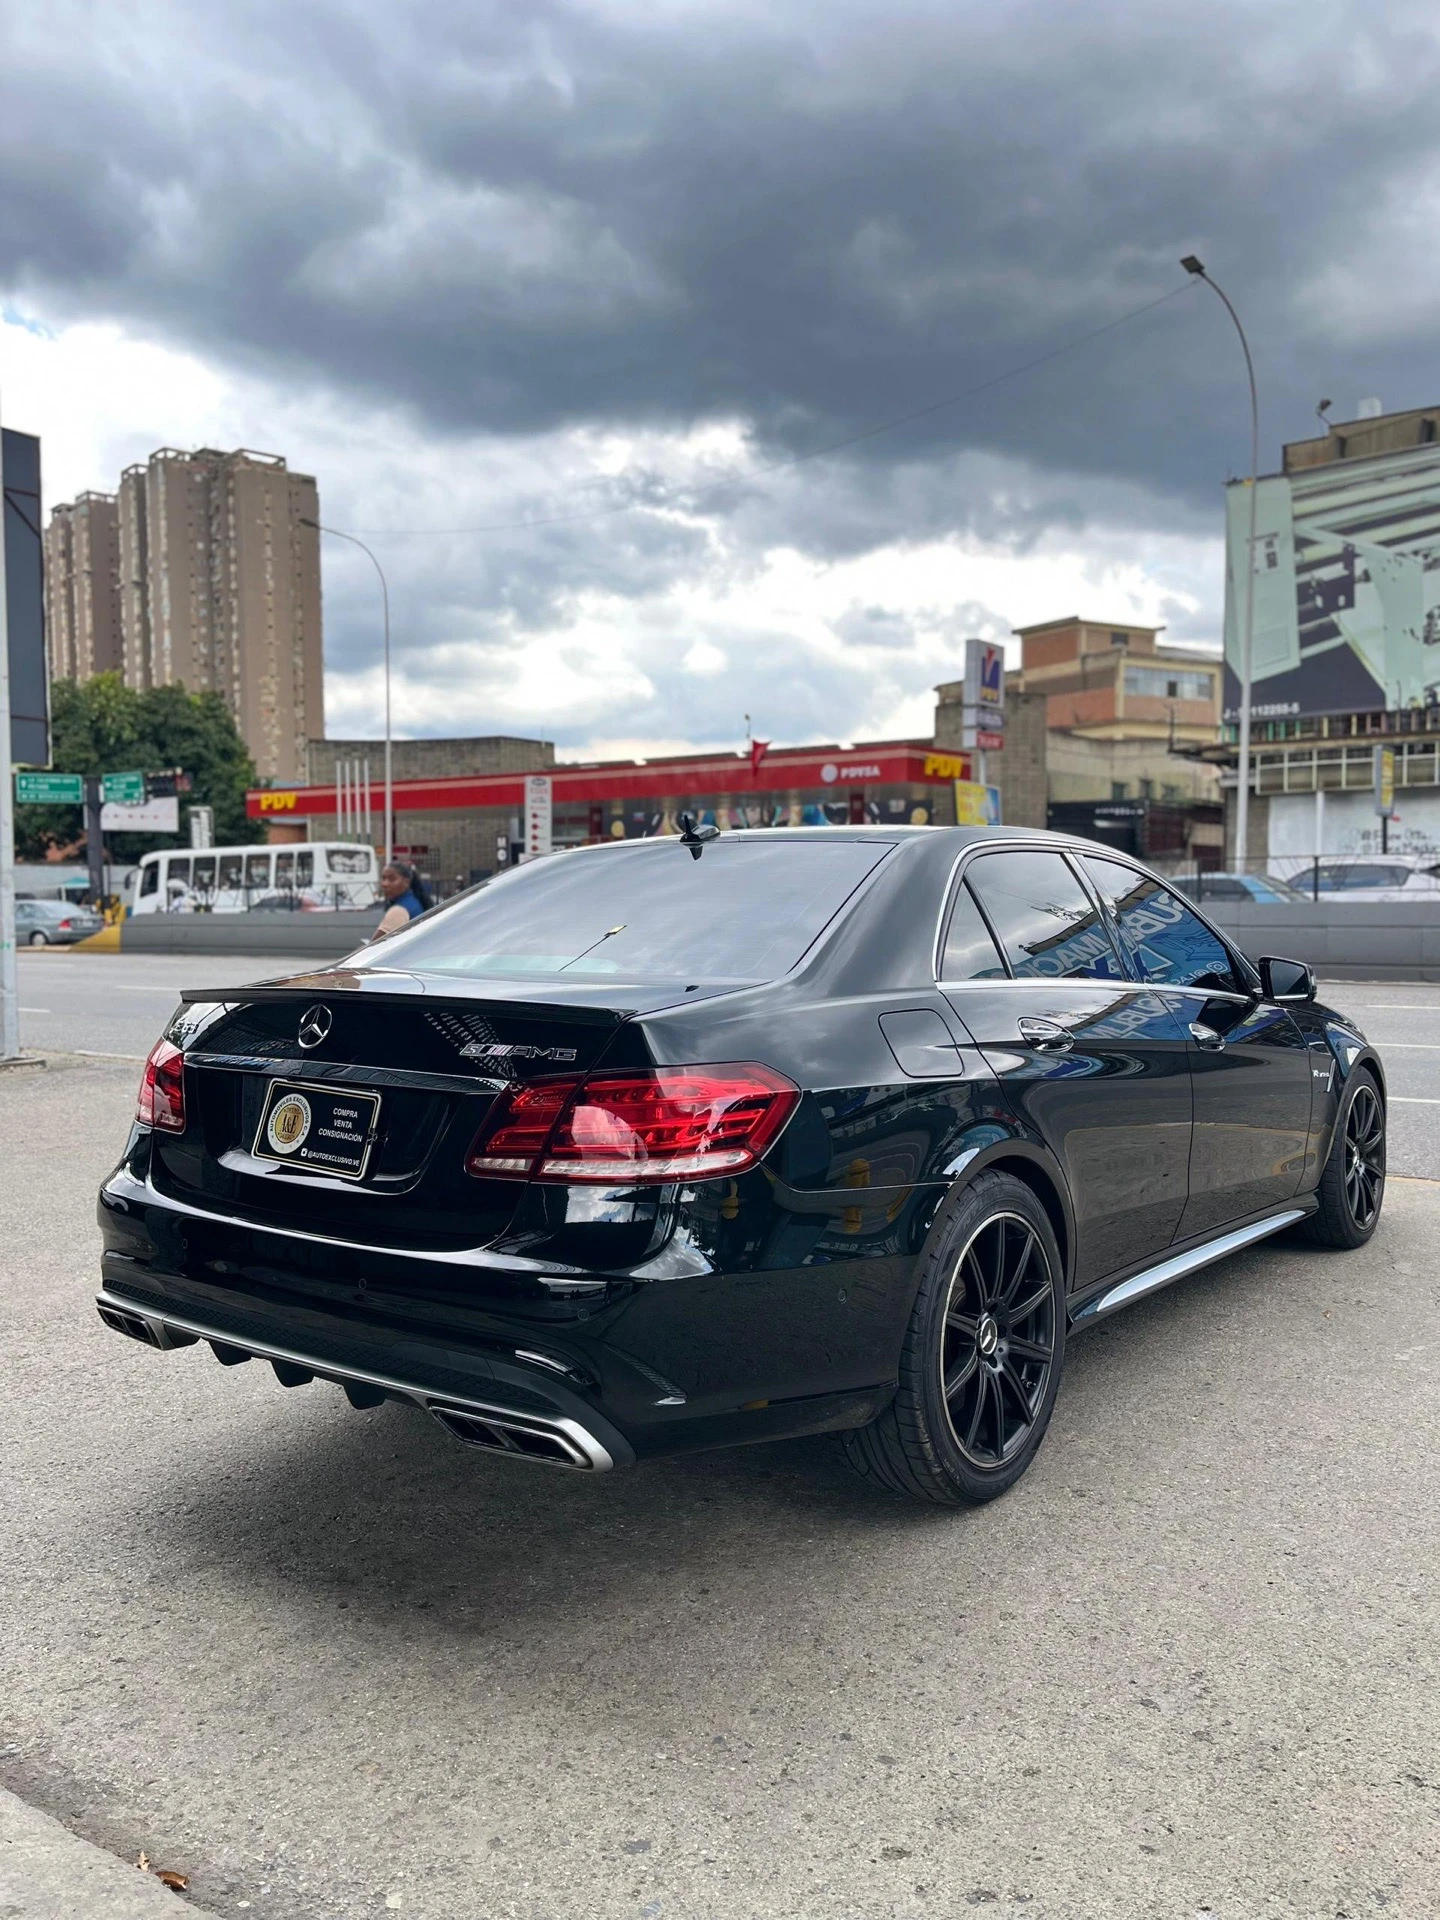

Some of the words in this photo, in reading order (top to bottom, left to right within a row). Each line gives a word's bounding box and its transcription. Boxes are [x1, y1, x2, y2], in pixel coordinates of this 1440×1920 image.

[841, 765, 880, 779] PDVSA
[924, 754, 964, 778] PDV
[261, 792, 297, 810] PDV
[507, 1045, 578, 1061] AMG
[333, 1107, 358, 1119] COMPRA
[333, 1118, 353, 1130] VENTA
[318, 1127, 363, 1143] CONSIGNACIÓN
